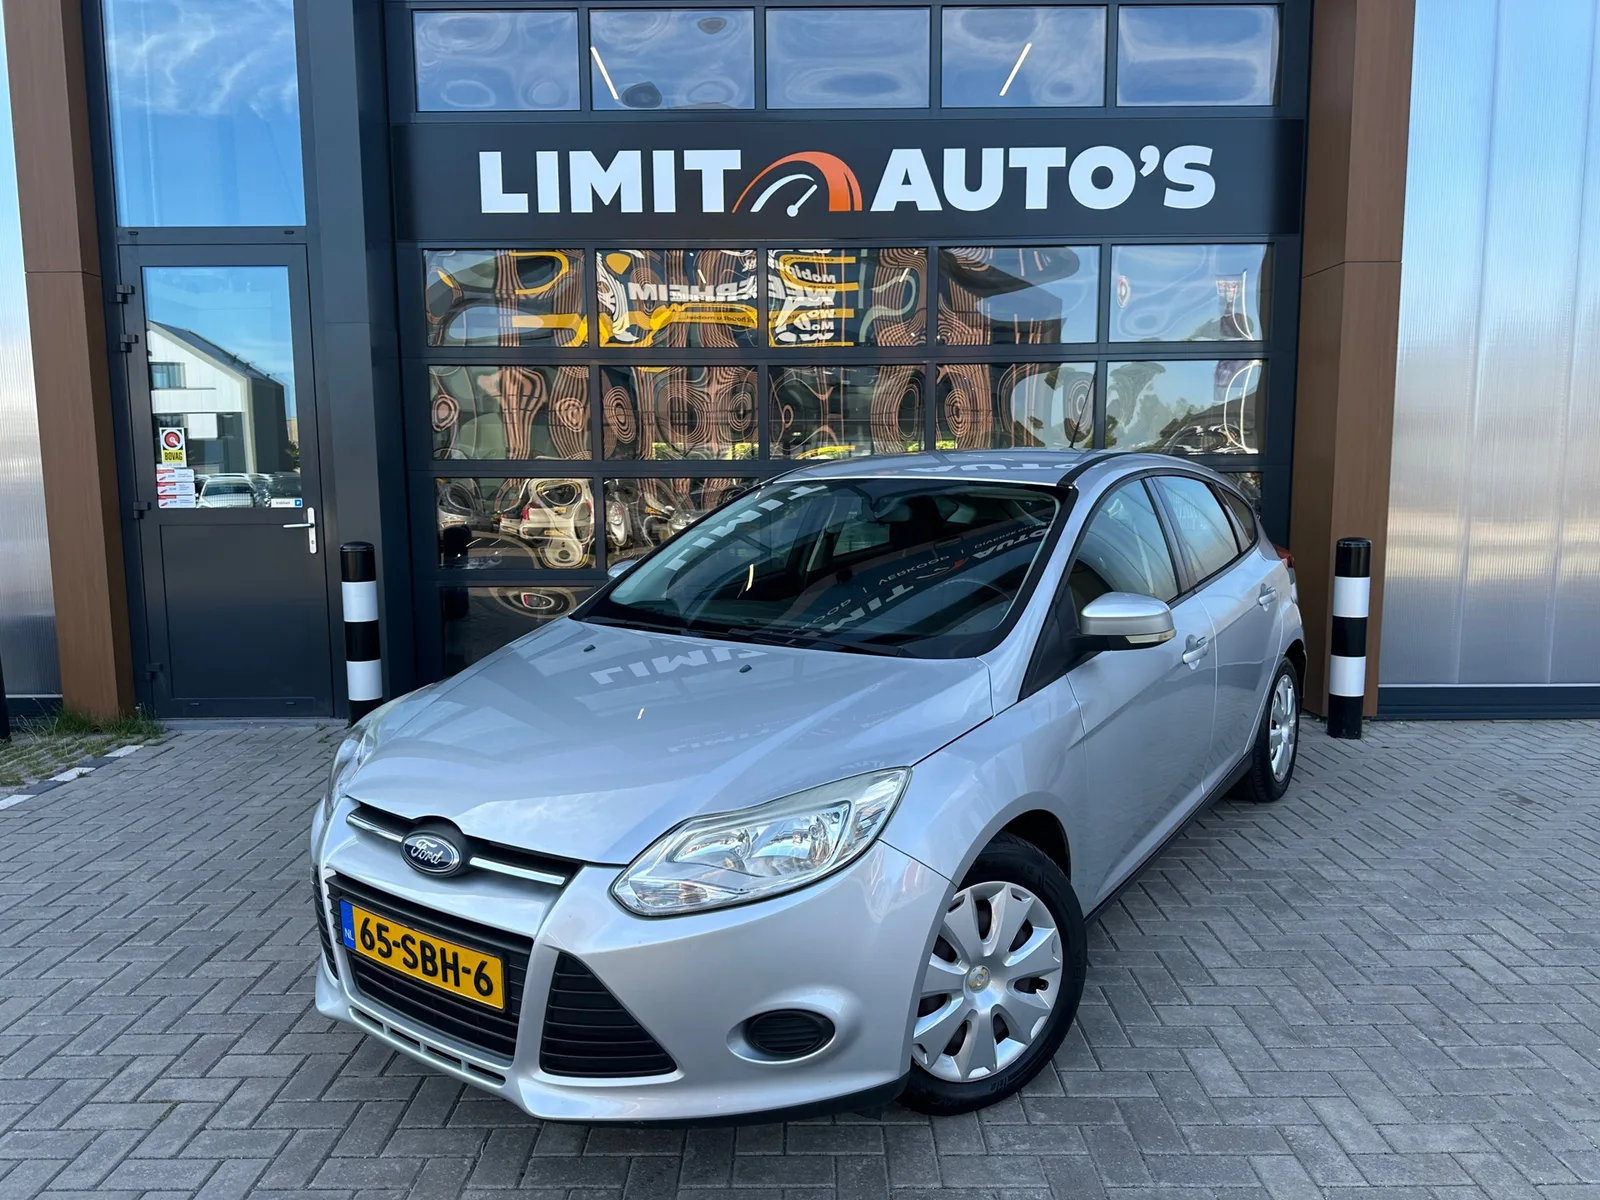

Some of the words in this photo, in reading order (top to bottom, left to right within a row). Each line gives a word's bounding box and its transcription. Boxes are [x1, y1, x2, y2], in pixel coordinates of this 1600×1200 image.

[479, 149, 742, 215] LIMIT
[870, 144, 1217, 213] AUTO'S
[164, 451, 183, 461] BOVAG
[411, 838, 444, 866] Ford
[344, 928, 355, 942] NL
[358, 917, 494, 997] 65-SBH-6
